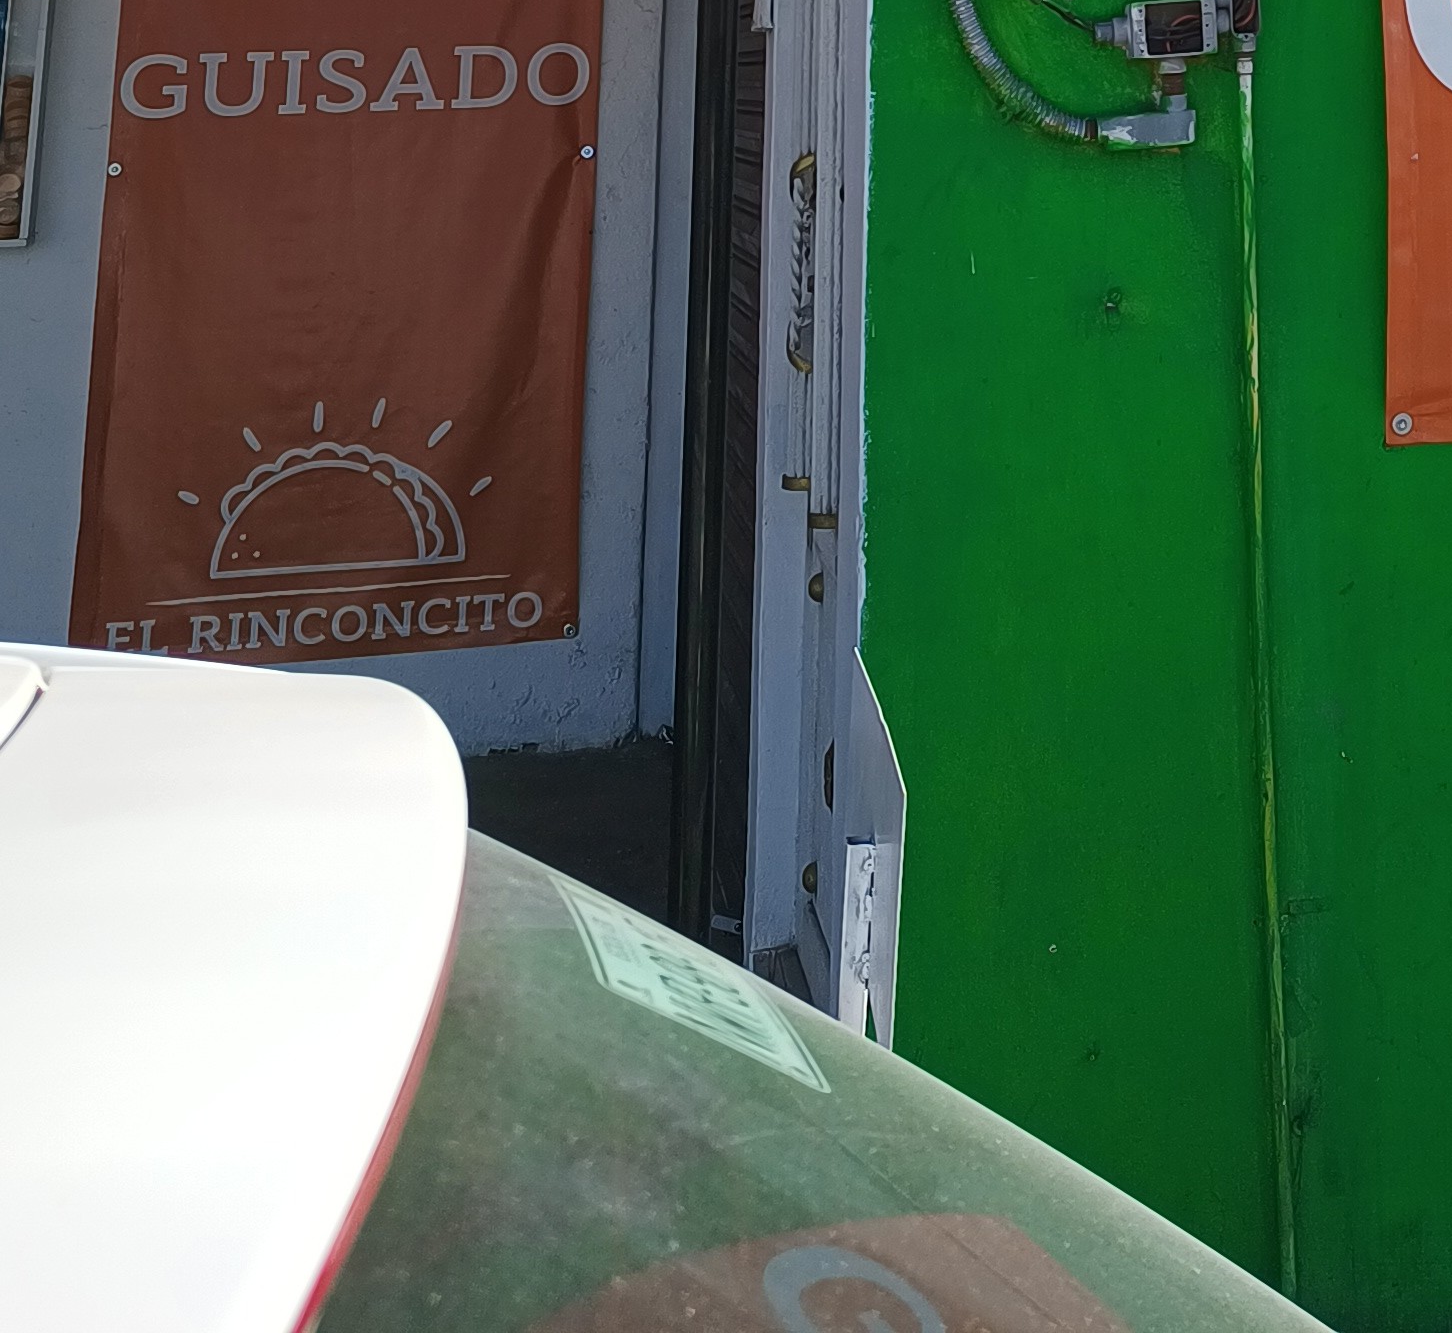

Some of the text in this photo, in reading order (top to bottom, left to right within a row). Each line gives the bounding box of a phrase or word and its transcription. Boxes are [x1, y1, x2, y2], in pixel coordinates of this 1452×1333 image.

[120, 42, 590, 119] GUISADO
[105, 591, 544, 654] EL RINCONCITO
